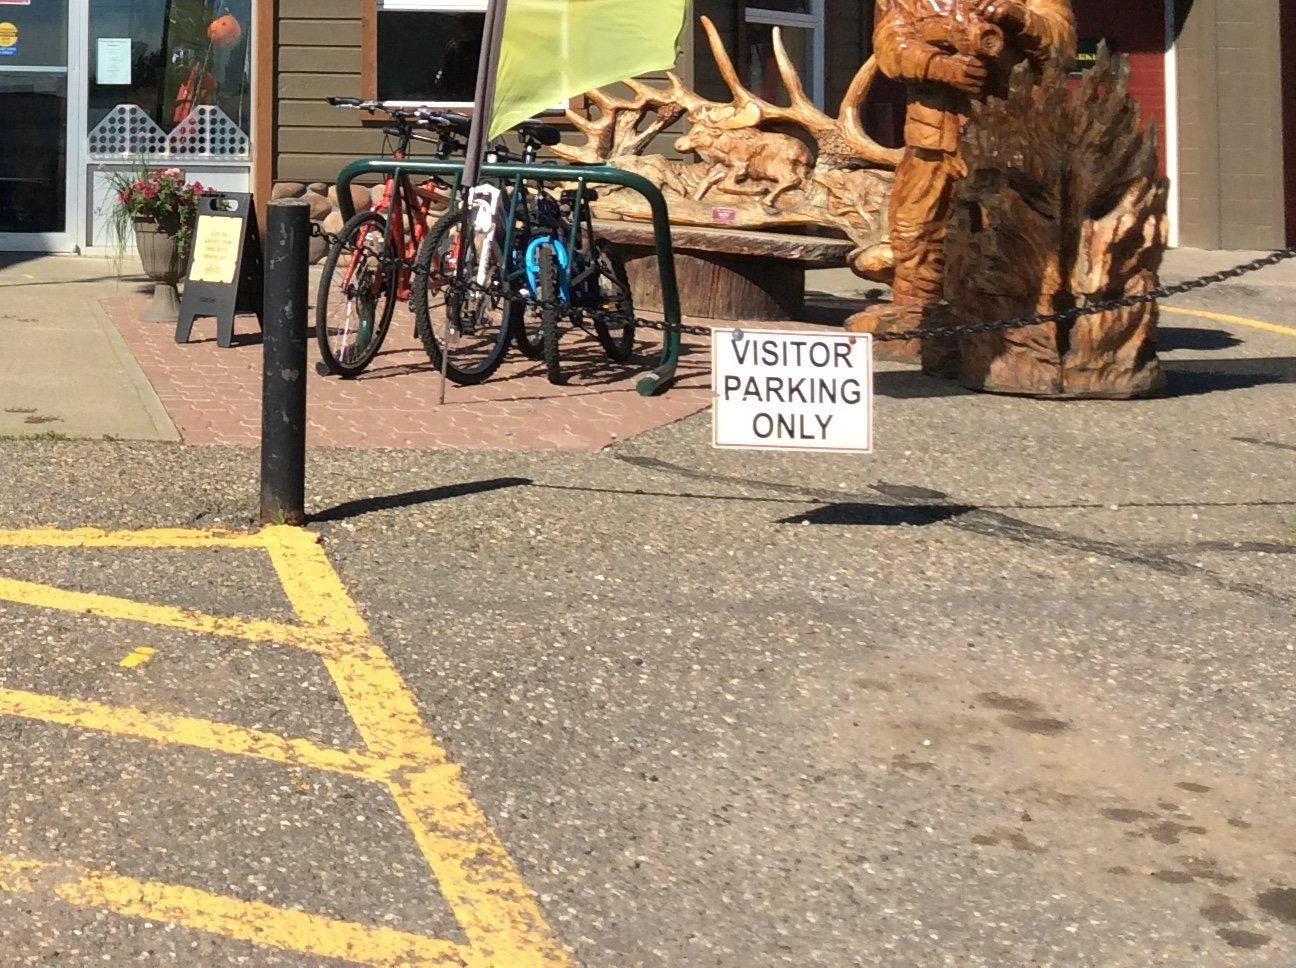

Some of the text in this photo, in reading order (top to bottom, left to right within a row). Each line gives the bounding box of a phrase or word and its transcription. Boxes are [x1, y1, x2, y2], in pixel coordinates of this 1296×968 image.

[731, 339, 853, 368] VISITOR
[724, 375, 861, 404] PARKING
[752, 412, 834, 439] ONLY
